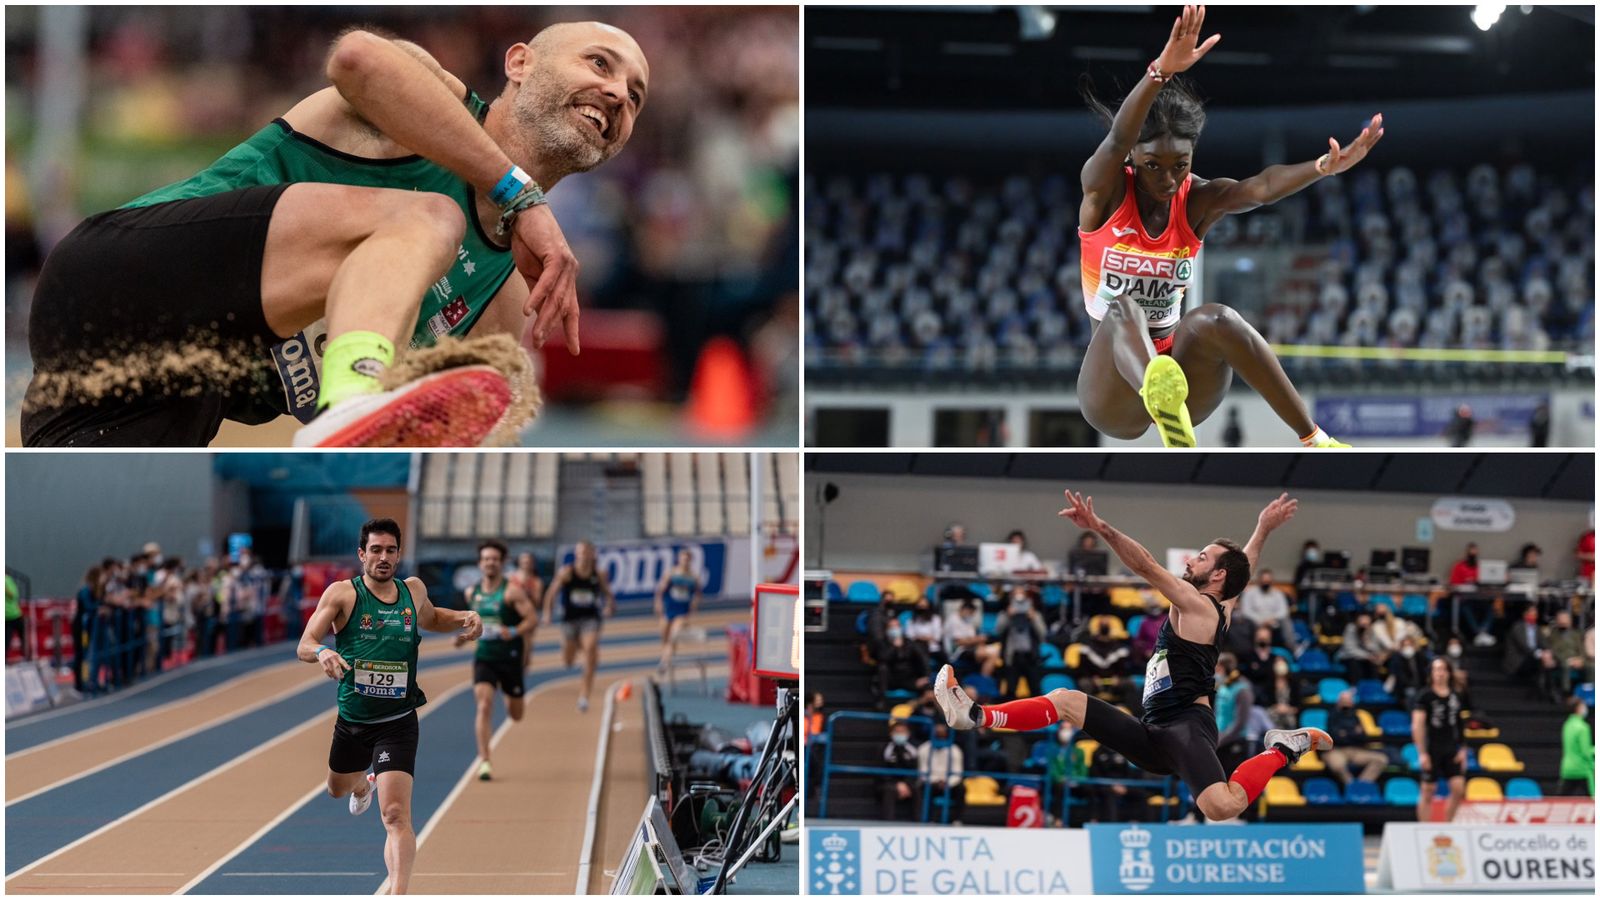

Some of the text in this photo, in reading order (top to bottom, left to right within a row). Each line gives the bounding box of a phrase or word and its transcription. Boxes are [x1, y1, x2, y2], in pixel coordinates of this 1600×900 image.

[1105, 253, 1173, 276] SPAR
[1149, 308, 1172, 320] 2021
[281, 333, 319, 409] oma
[368, 673, 395, 686] 129
[877, 836, 994, 861] XUNTA
[1166, 834, 1325, 858] DEPUTACIÓN
[1478, 833, 1587, 851] Concello de
[876, 870, 1070, 894] DE GALICIA
[1166, 863, 1285, 882] OURENSE
